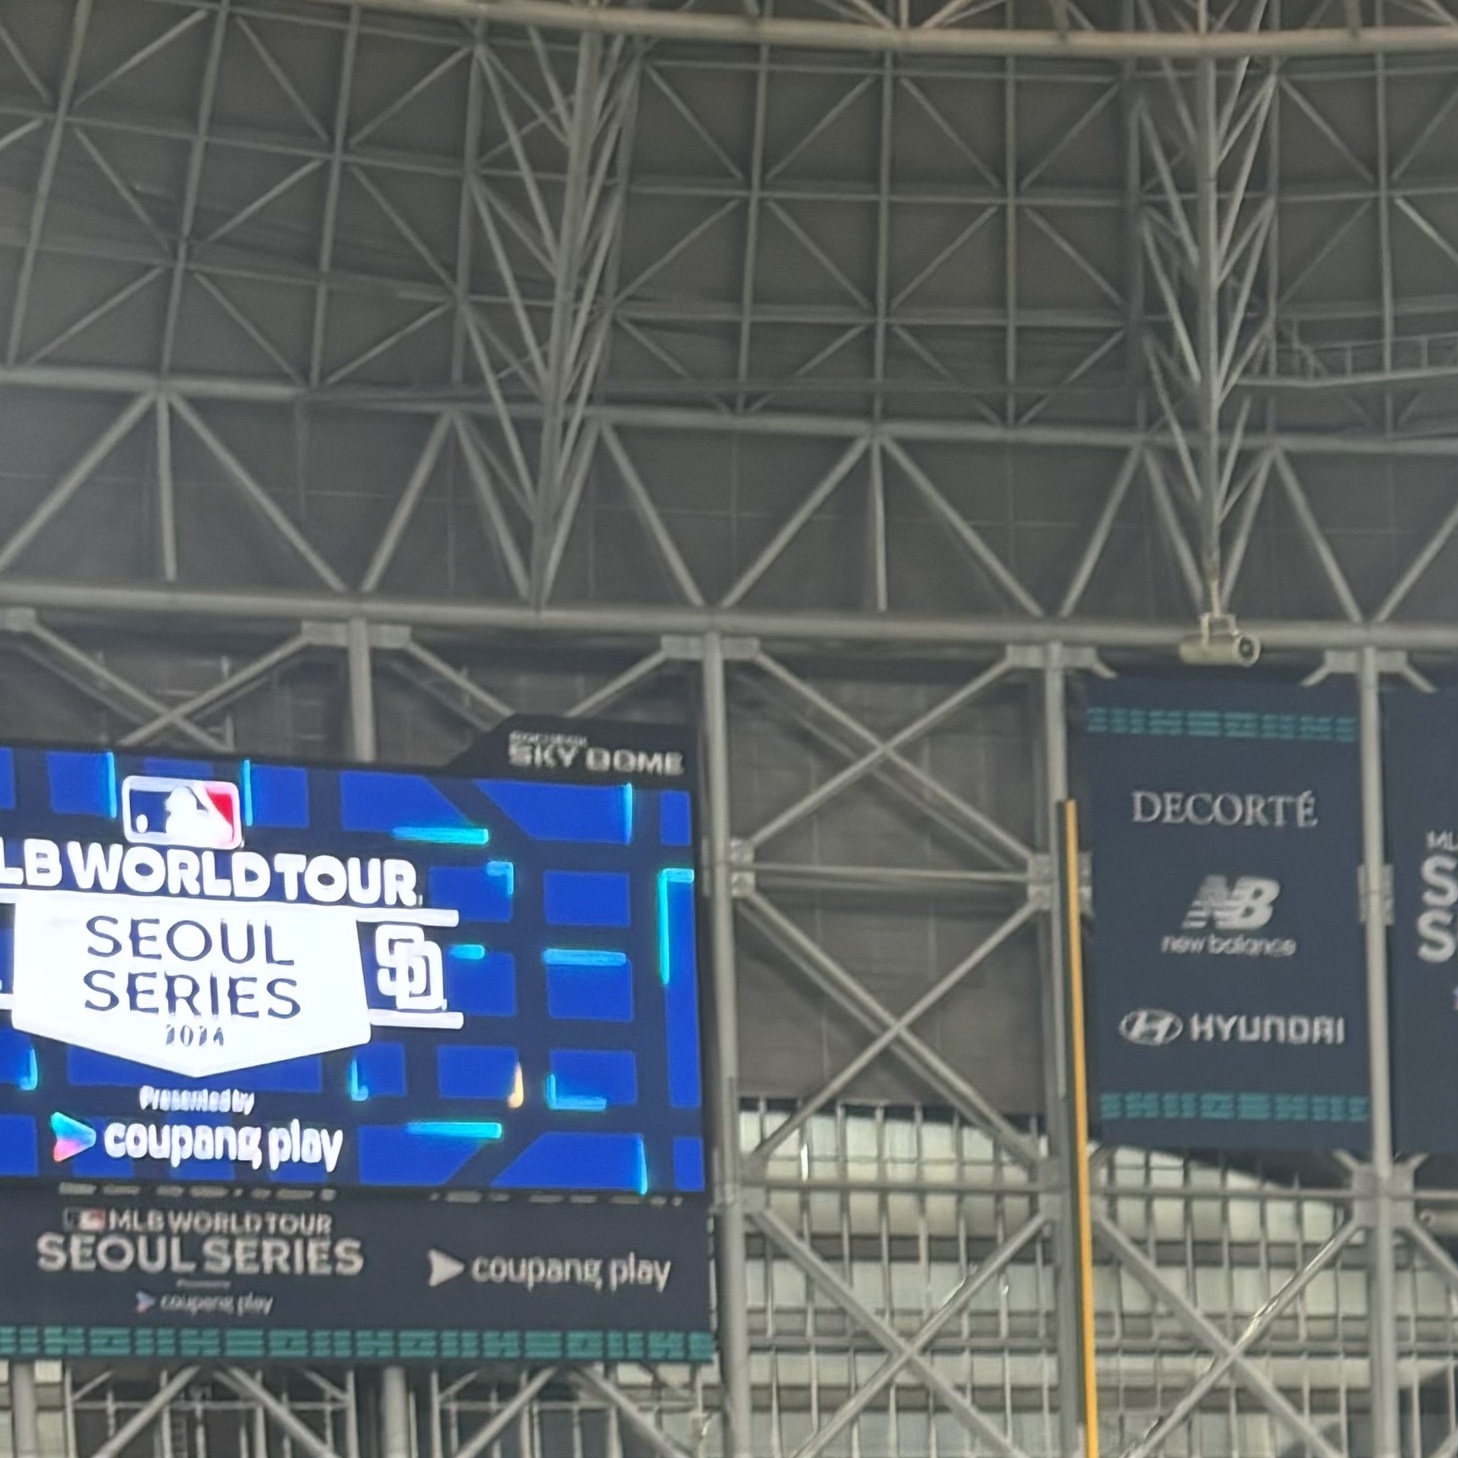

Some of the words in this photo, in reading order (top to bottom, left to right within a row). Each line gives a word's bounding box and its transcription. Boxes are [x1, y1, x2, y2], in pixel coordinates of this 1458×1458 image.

[585, 747, 684, 776] DOME
[1131, 790, 1318, 828] DECORTÉ
[67, 841, 271, 898] WORLD
[274, 853, 417, 906] TOUR
[85, 915, 295, 966] SEOUL
[1161, 935, 1205, 953] new
[1207, 933, 1297, 957] balance
[83, 970, 301, 1019] SERIES
[1190, 1012, 1345, 1045] HYUNDAI
[103, 1121, 262, 1171] coupang
[267, 1117, 343, 1173] play
[109, 1207, 165, 1232] MLB
[166, 1209, 263, 1235] WORLD
[263, 1211, 333, 1236] TOUR
[36, 1231, 196, 1274] SEOUL
[203, 1235, 364, 1276] SERIES
[471, 1255, 603, 1293] coupang
[608, 1251, 672, 1294] play
[160, 1293, 234, 1316] coupang
[235, 1291, 273, 1316] play
